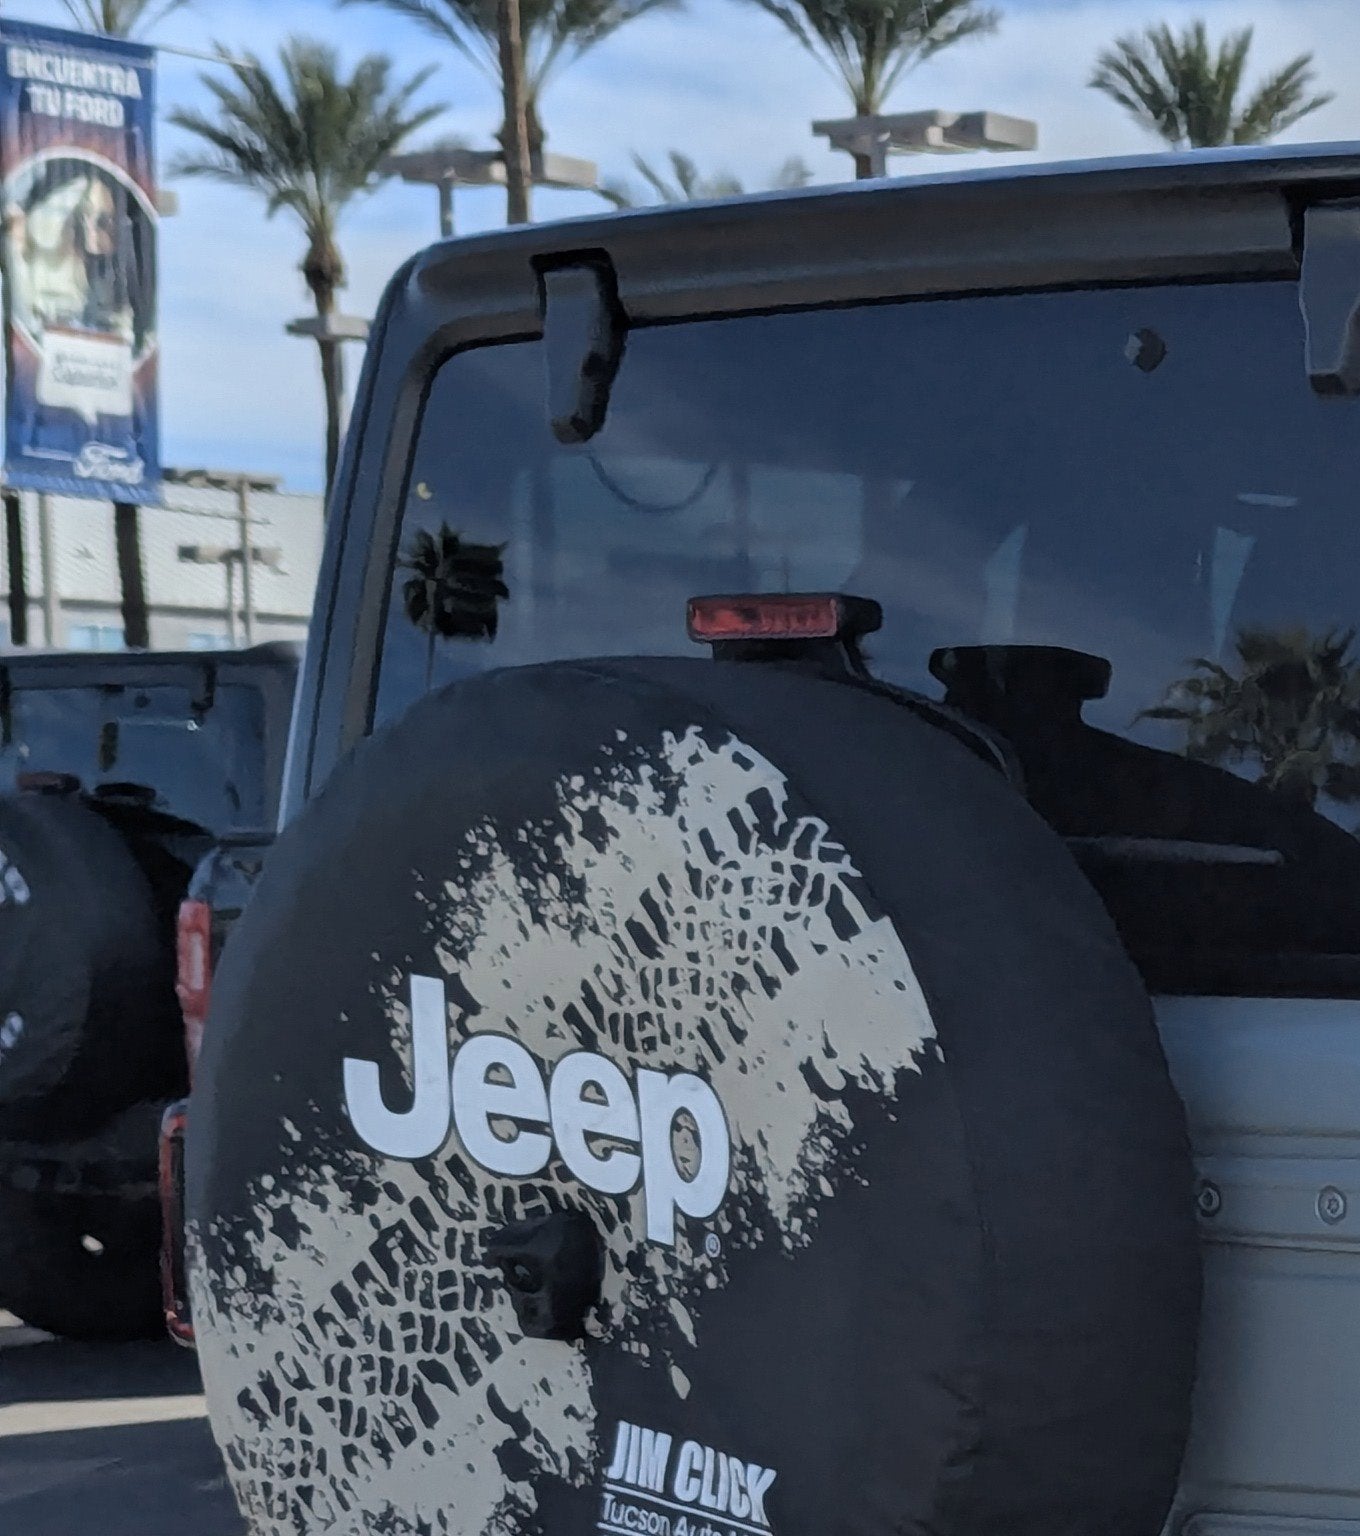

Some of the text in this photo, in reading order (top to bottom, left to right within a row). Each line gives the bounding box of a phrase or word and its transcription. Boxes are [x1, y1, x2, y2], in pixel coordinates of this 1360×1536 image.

[7, 45, 143, 100] ENCUENTRA
[25, 84, 125, 128] TU FORD
[343, 974, 730, 1246] Jeep
[606, 1420, 777, 1527] JIM CLICK
